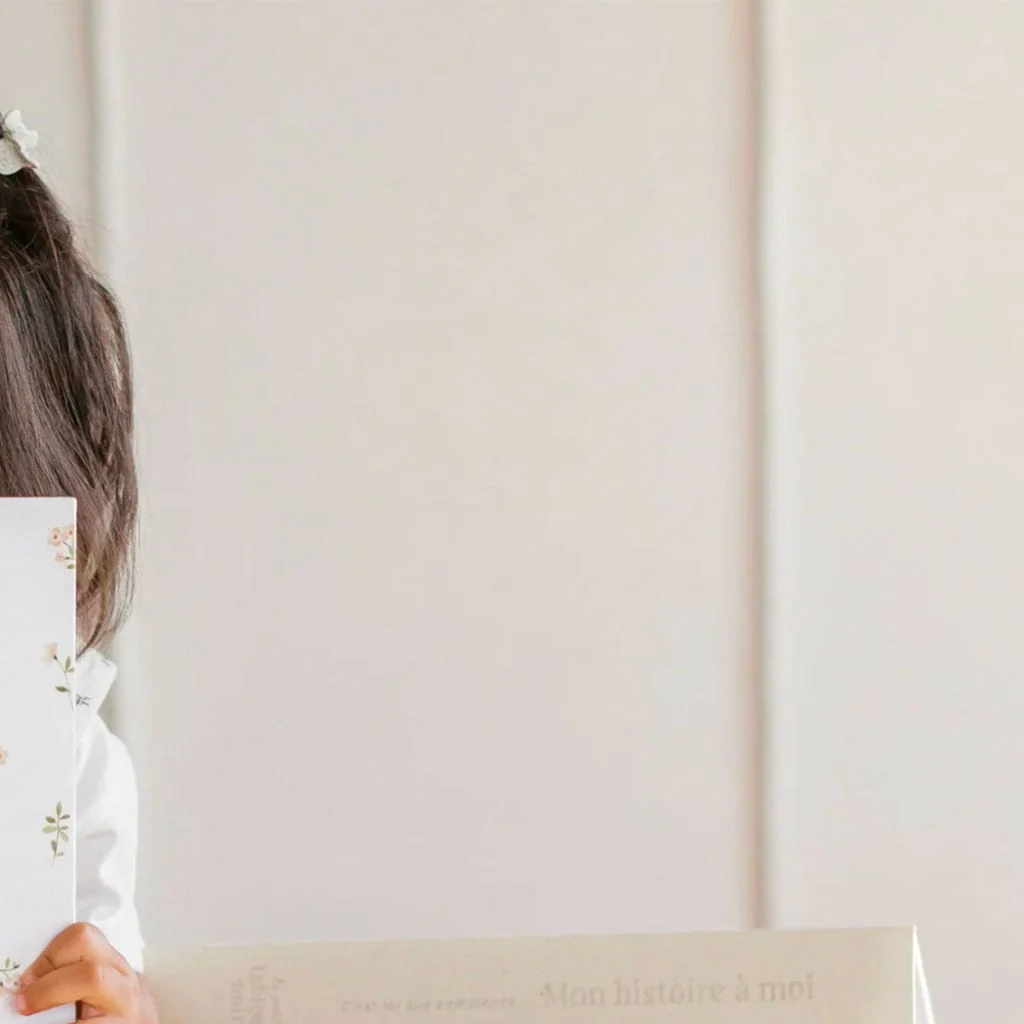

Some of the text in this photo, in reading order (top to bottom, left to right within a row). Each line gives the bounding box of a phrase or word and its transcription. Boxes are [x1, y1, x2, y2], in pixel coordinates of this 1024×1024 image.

[542, 980, 606, 1006] Mon
[614, 976, 724, 1006] histoire
[734, 974, 750, 1003] à
[759, 973, 817, 1002] moi
